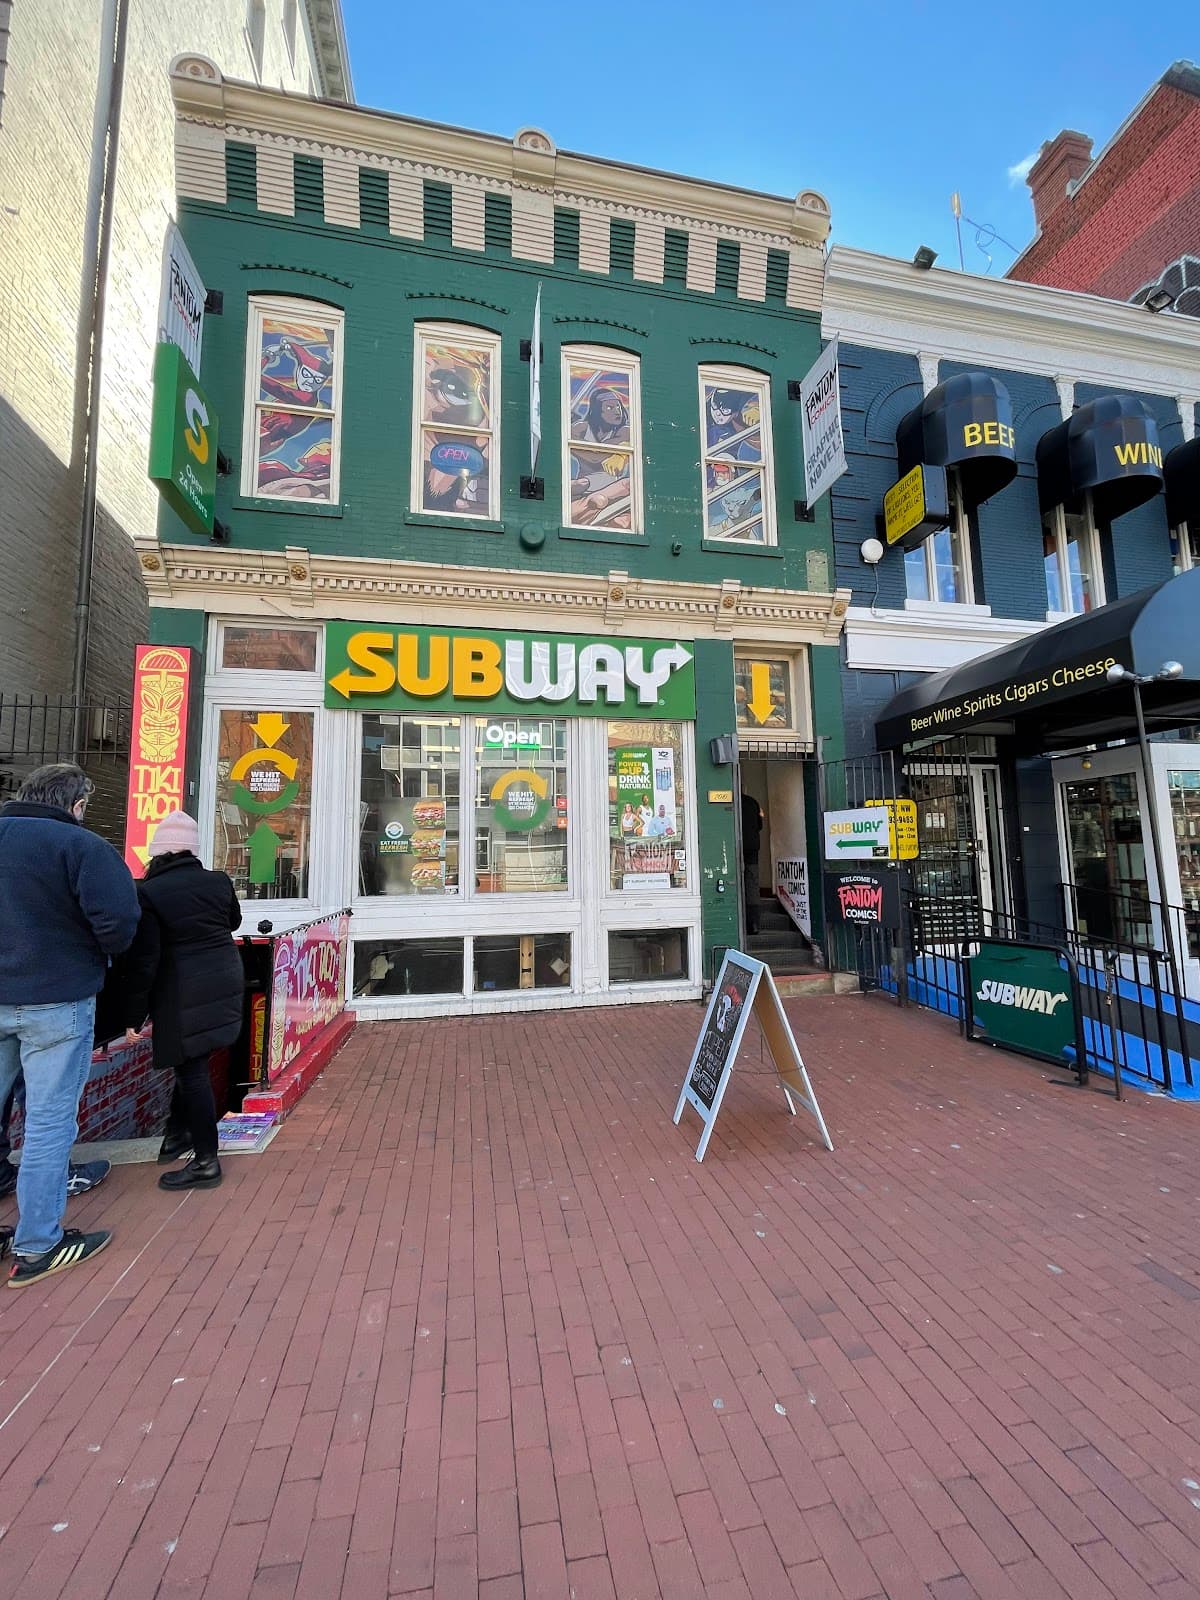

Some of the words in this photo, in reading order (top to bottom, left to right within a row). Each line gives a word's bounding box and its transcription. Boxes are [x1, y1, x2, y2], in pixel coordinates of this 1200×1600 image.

[170, 254, 202, 347] FANTOM
[805, 362, 838, 430] FANTOM
[811, 391, 837, 424] COMICS
[437, 447, 470, 461] OPEN
[806, 414, 840, 475] GRAPHIC
[186, 463, 203, 496] Open
[179, 471, 189, 491] 24
[189, 485, 208, 519] Hours
[328, 631, 694, 706] SUBWAY
[911, 715, 933, 732] Beer
[934, 705, 962, 724] Wine
[964, 693, 1002, 717] Spirits
[1004, 677, 1050, 702] Cigars
[1052, 657, 1116, 687] Cheese
[486, 725, 541, 749] Open
[133, 765, 182, 794] TIKI
[619, 775, 651, 784] DRINK
[629, 767, 643, 775] UP
[133, 792, 180, 821] TACO
[901, 804, 911, 812] NW
[829, 820, 884, 836] SUBWAY
[777, 861, 805, 881] FANTOM
[840, 875, 871, 884] WELCOME
[788, 882, 806, 896] COMICS
[837, 885, 883, 923] FANTOM
[845, 908, 878, 920] COMICS
[976, 979, 1069, 1016] SUBWAY
